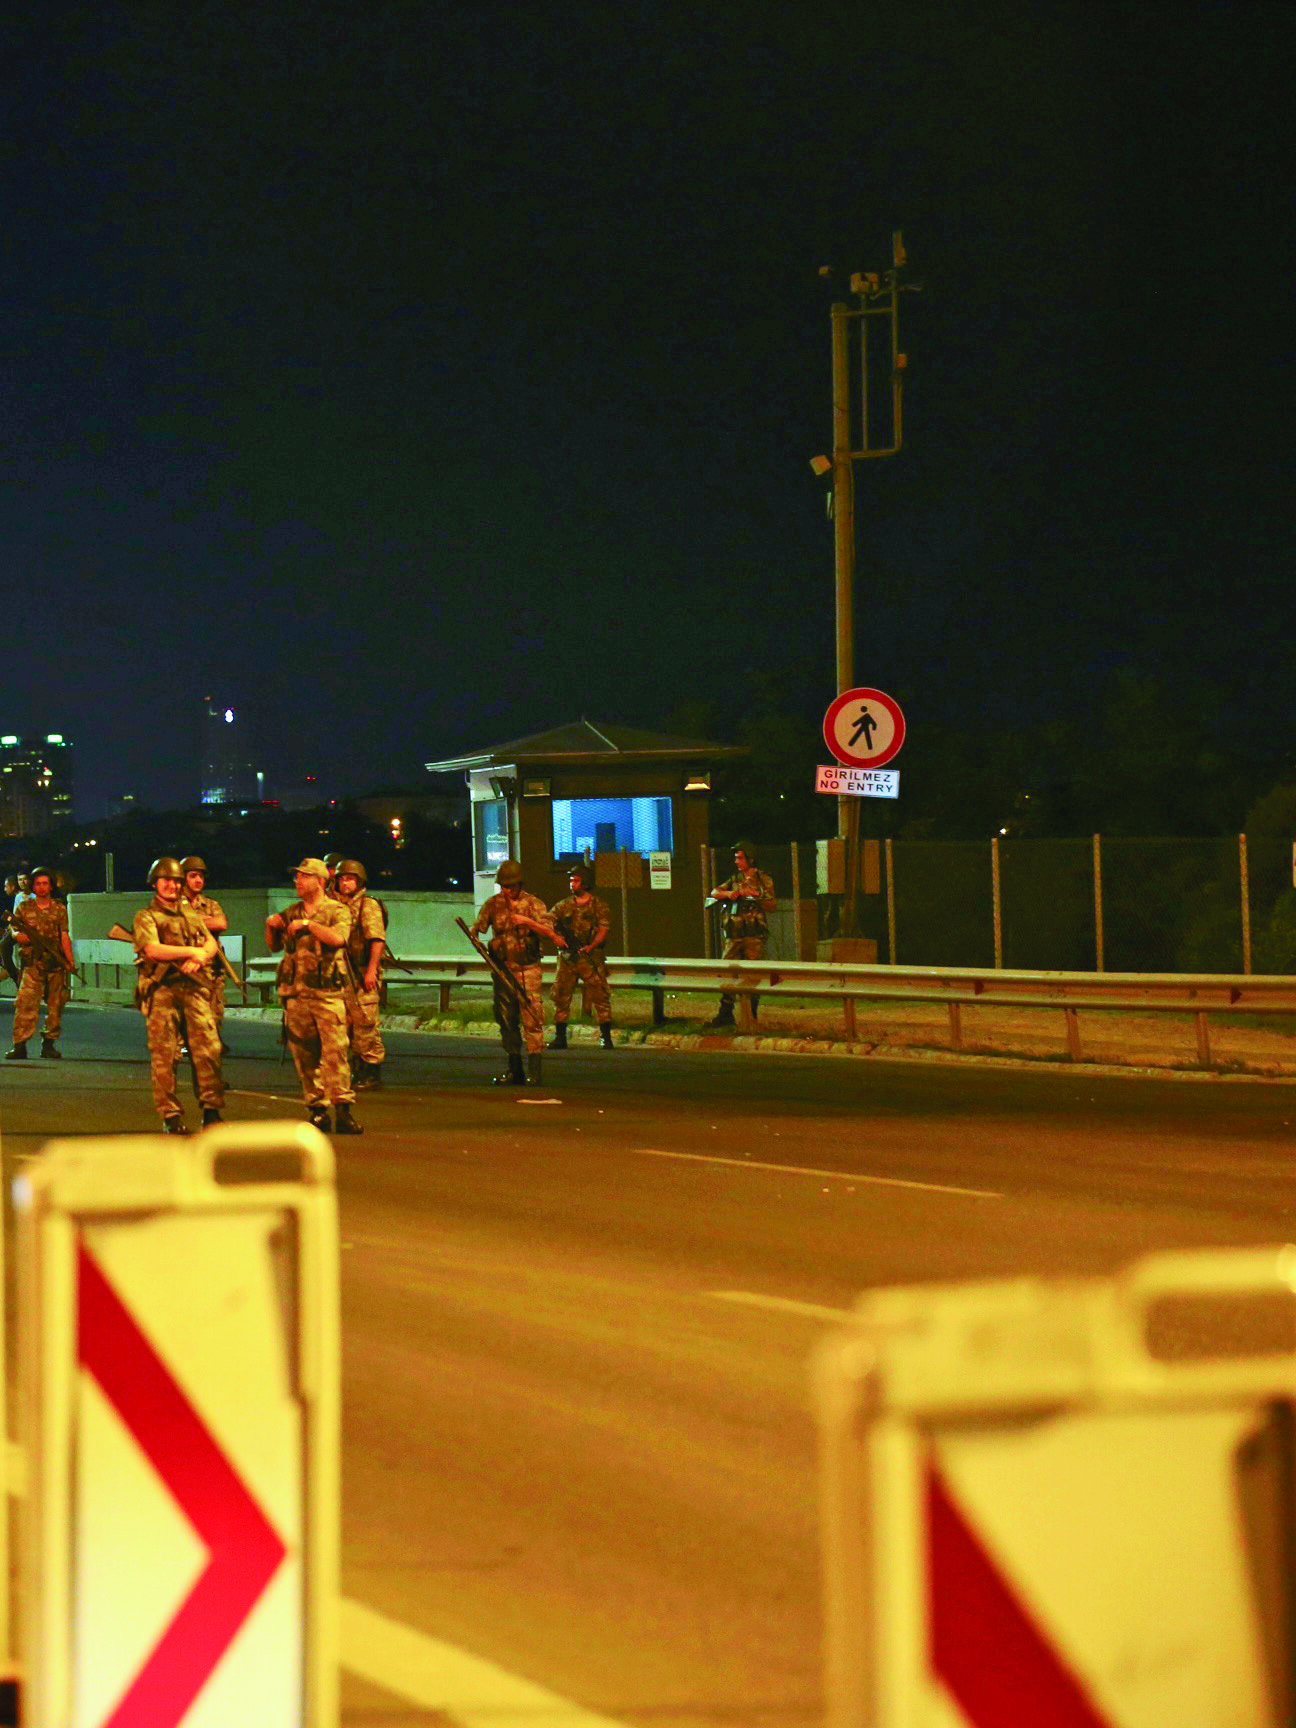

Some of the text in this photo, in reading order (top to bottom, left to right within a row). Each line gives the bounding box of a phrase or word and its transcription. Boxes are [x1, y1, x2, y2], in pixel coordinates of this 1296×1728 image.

[824, 769, 891, 782] GİRİLMEZ
[820, 780, 893, 792] NO ENTRY
